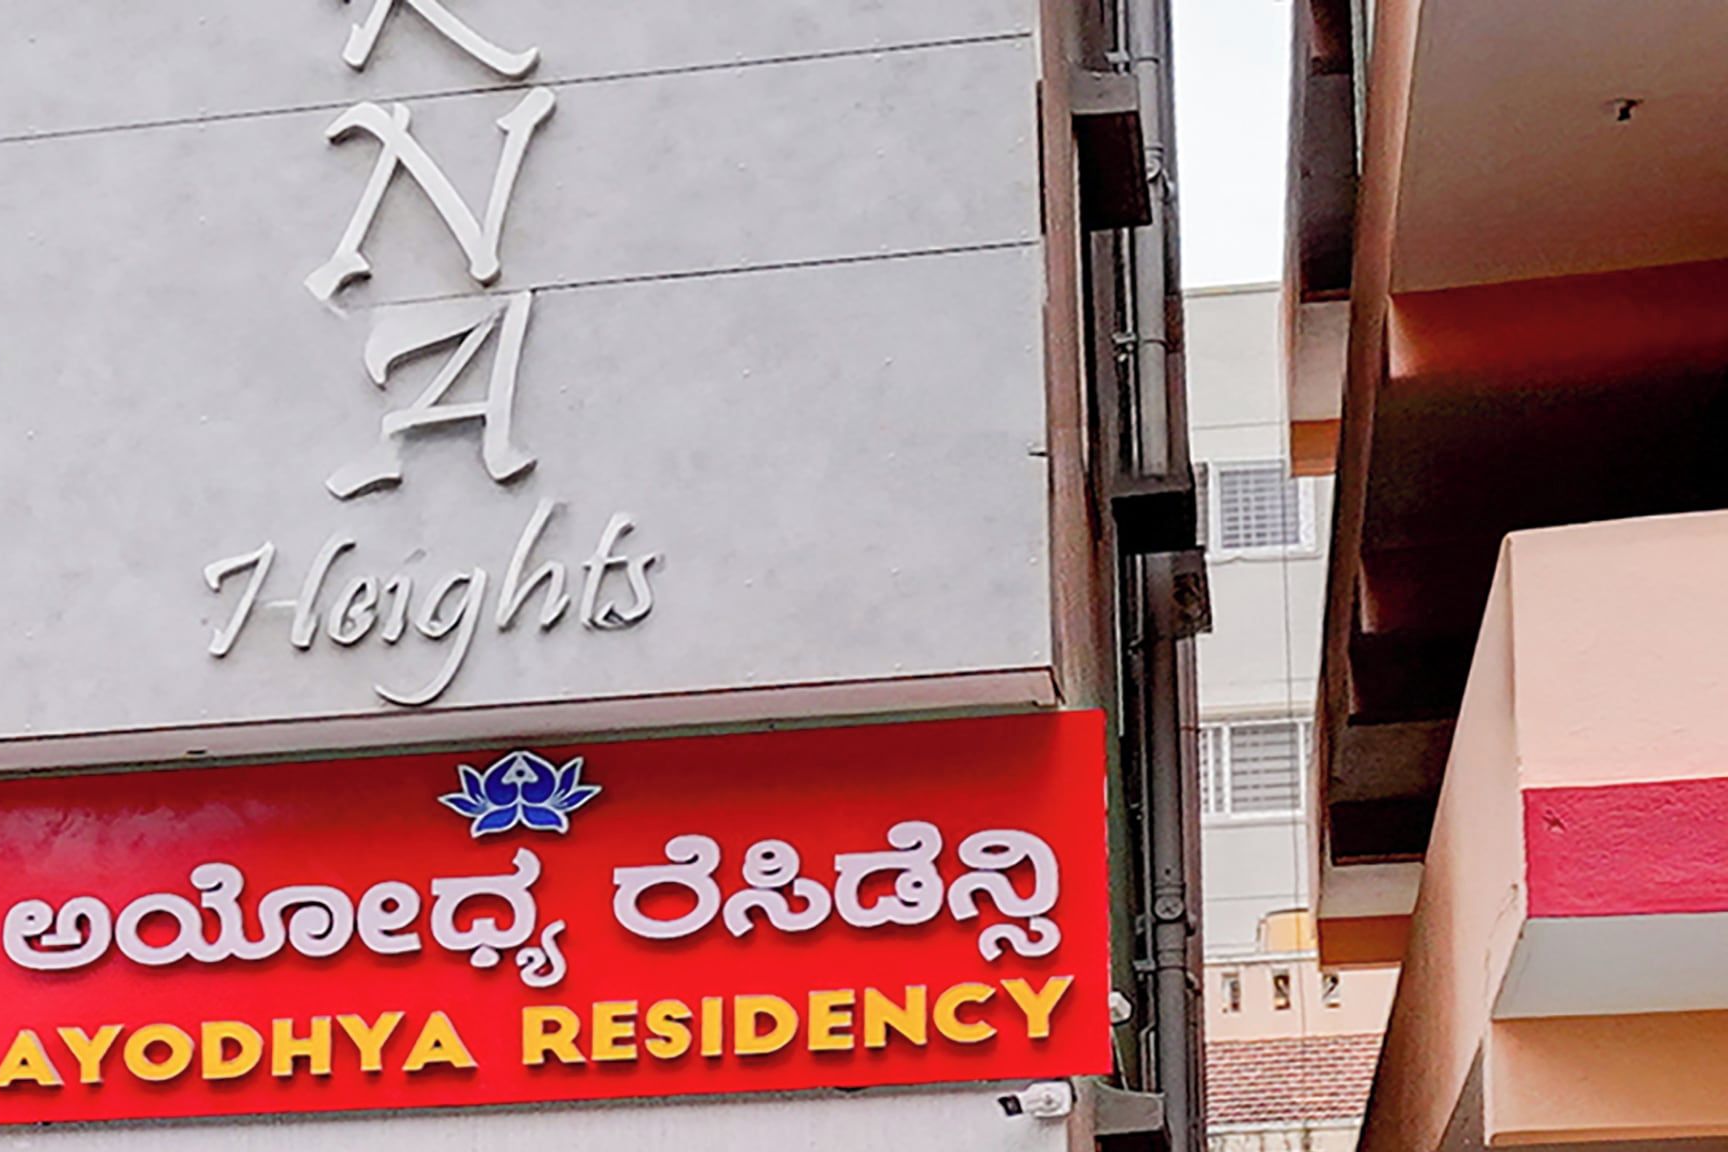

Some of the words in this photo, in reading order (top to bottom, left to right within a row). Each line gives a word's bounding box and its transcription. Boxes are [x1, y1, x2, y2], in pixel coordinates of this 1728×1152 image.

[203, 499, 664, 706] Heights
[3, 846, 568, 989] ಅಯೋಧ್ಯ
[612, 820, 1062, 962] ರೆಸಿಡೆನ್ಸಿ
[521, 974, 1075, 1068] RESIDENCY
